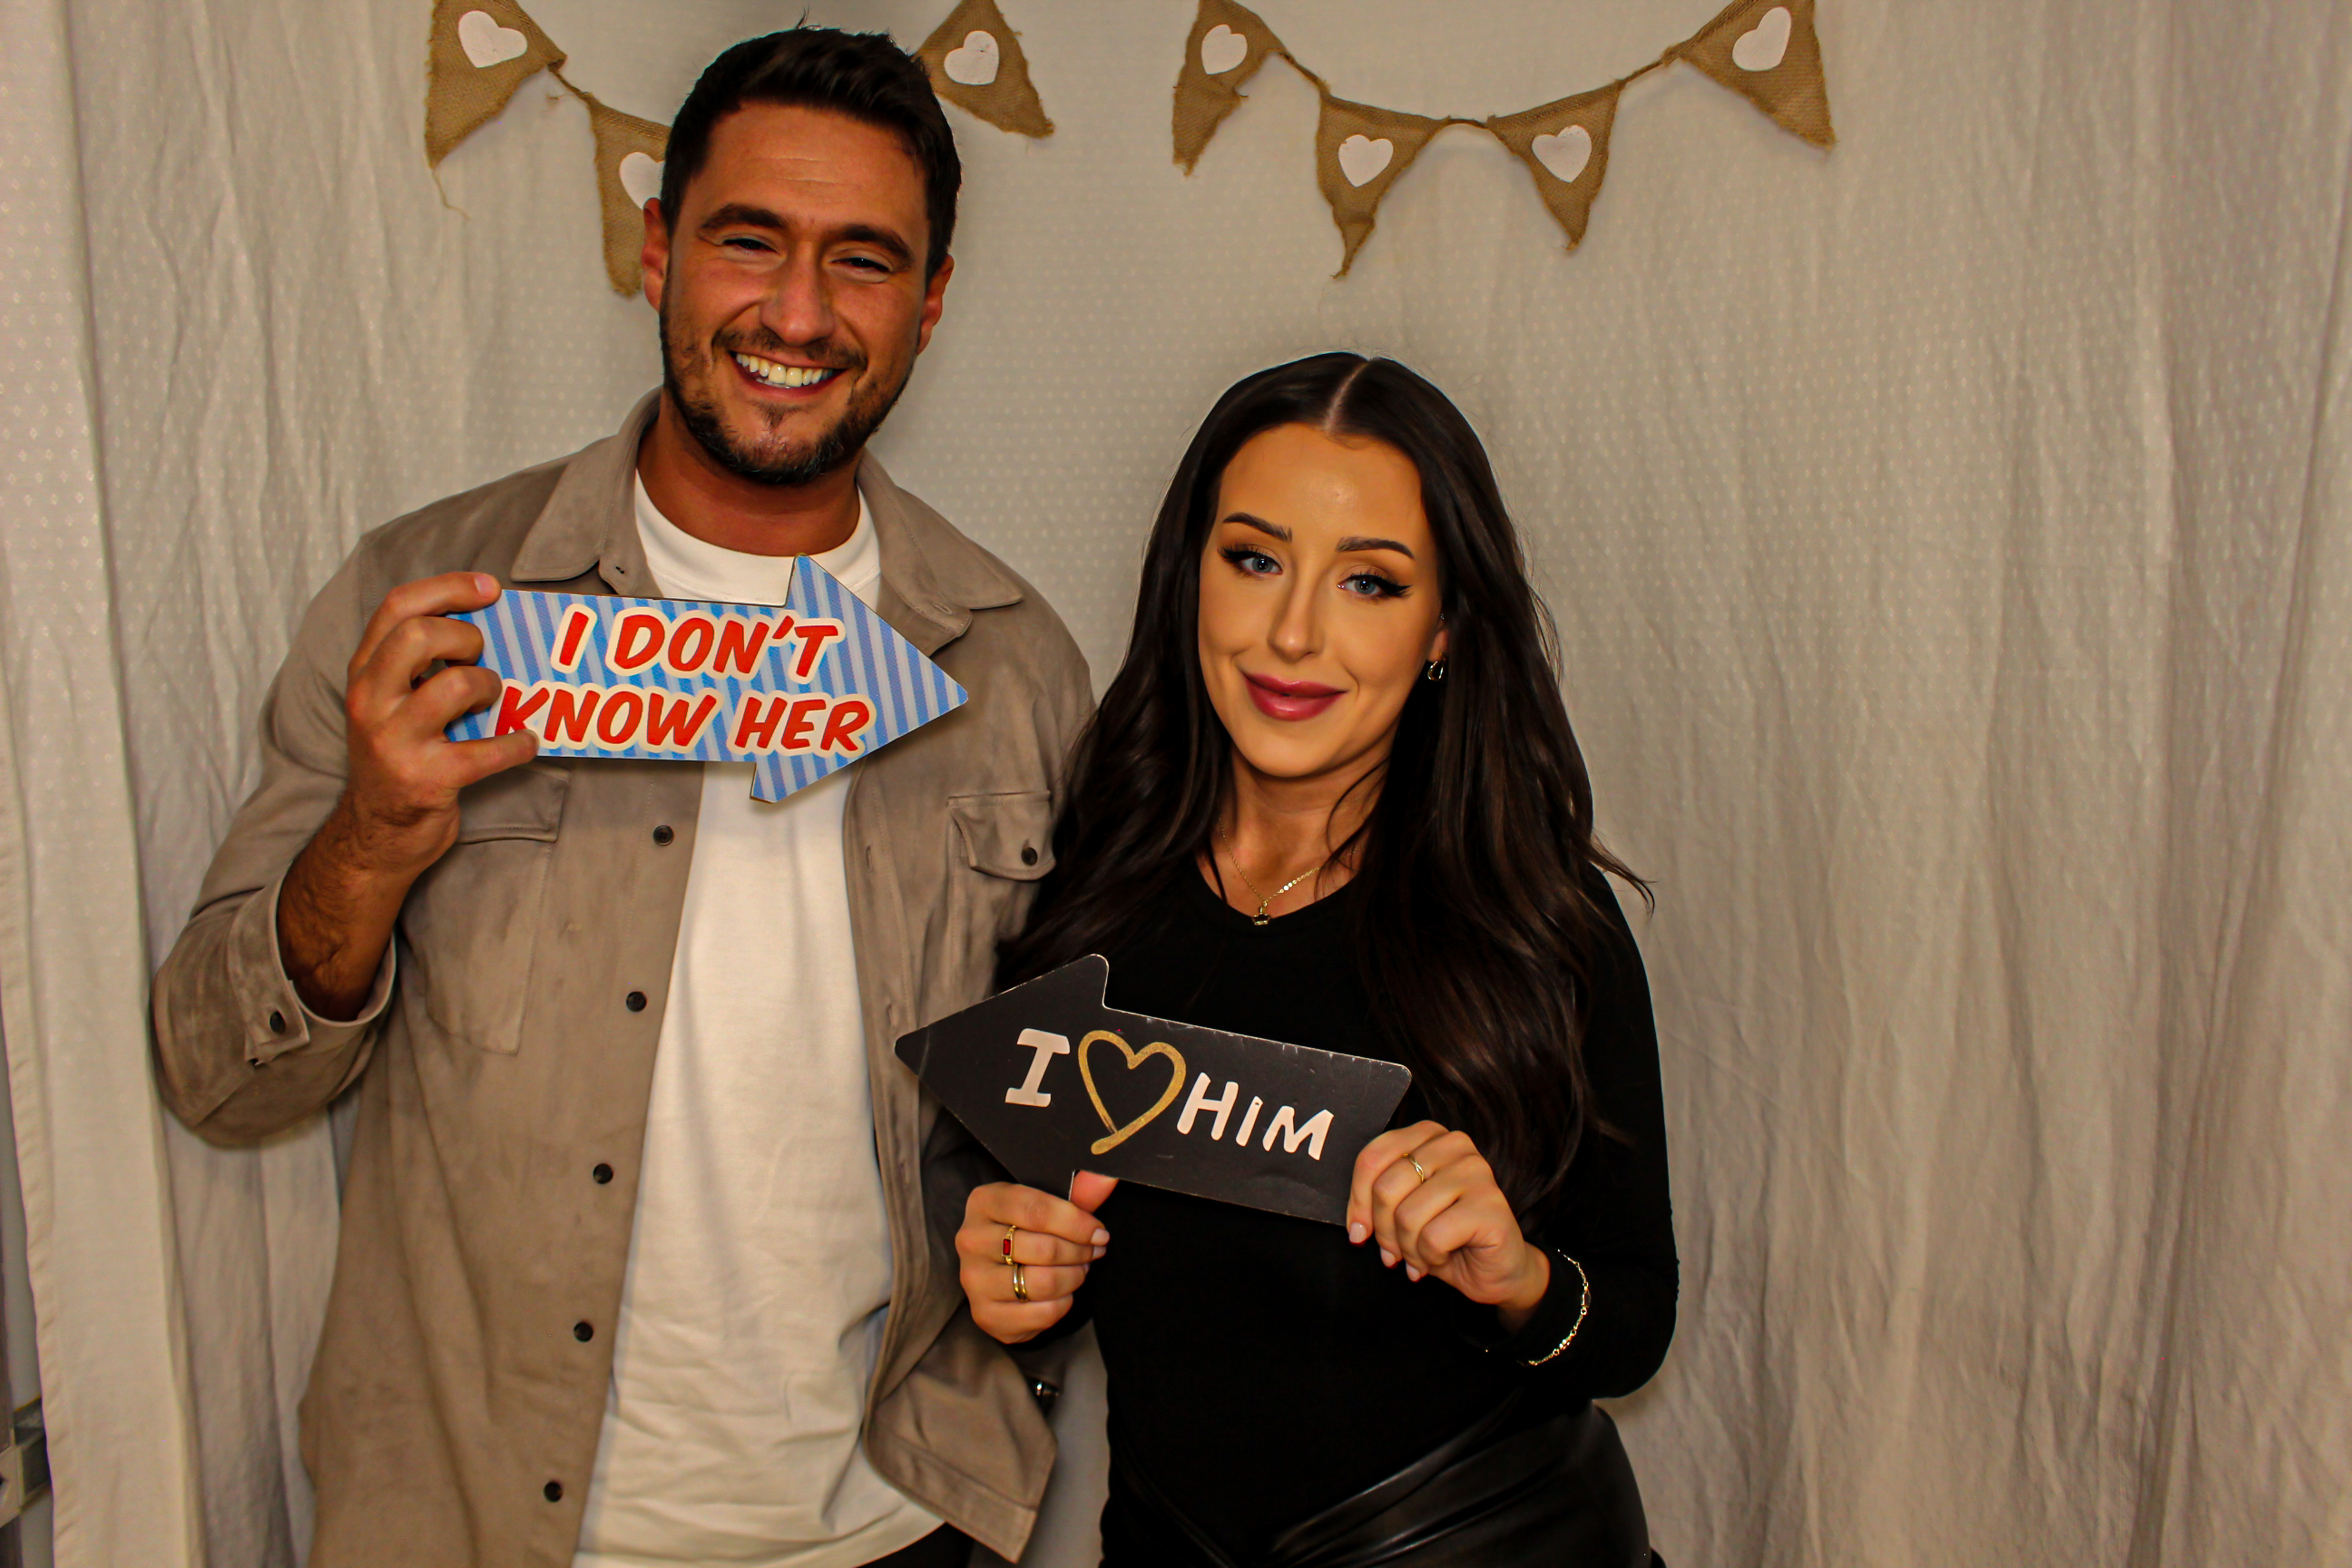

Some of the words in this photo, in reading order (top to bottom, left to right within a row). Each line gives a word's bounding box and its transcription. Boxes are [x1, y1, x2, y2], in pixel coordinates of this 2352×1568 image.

[556, 609, 592, 670] I
[612, 612, 840, 681] DON'T
[493, 682, 719, 749] KNOW
[732, 693, 871, 753] HER
[1004, 1027, 1071, 1108] I
